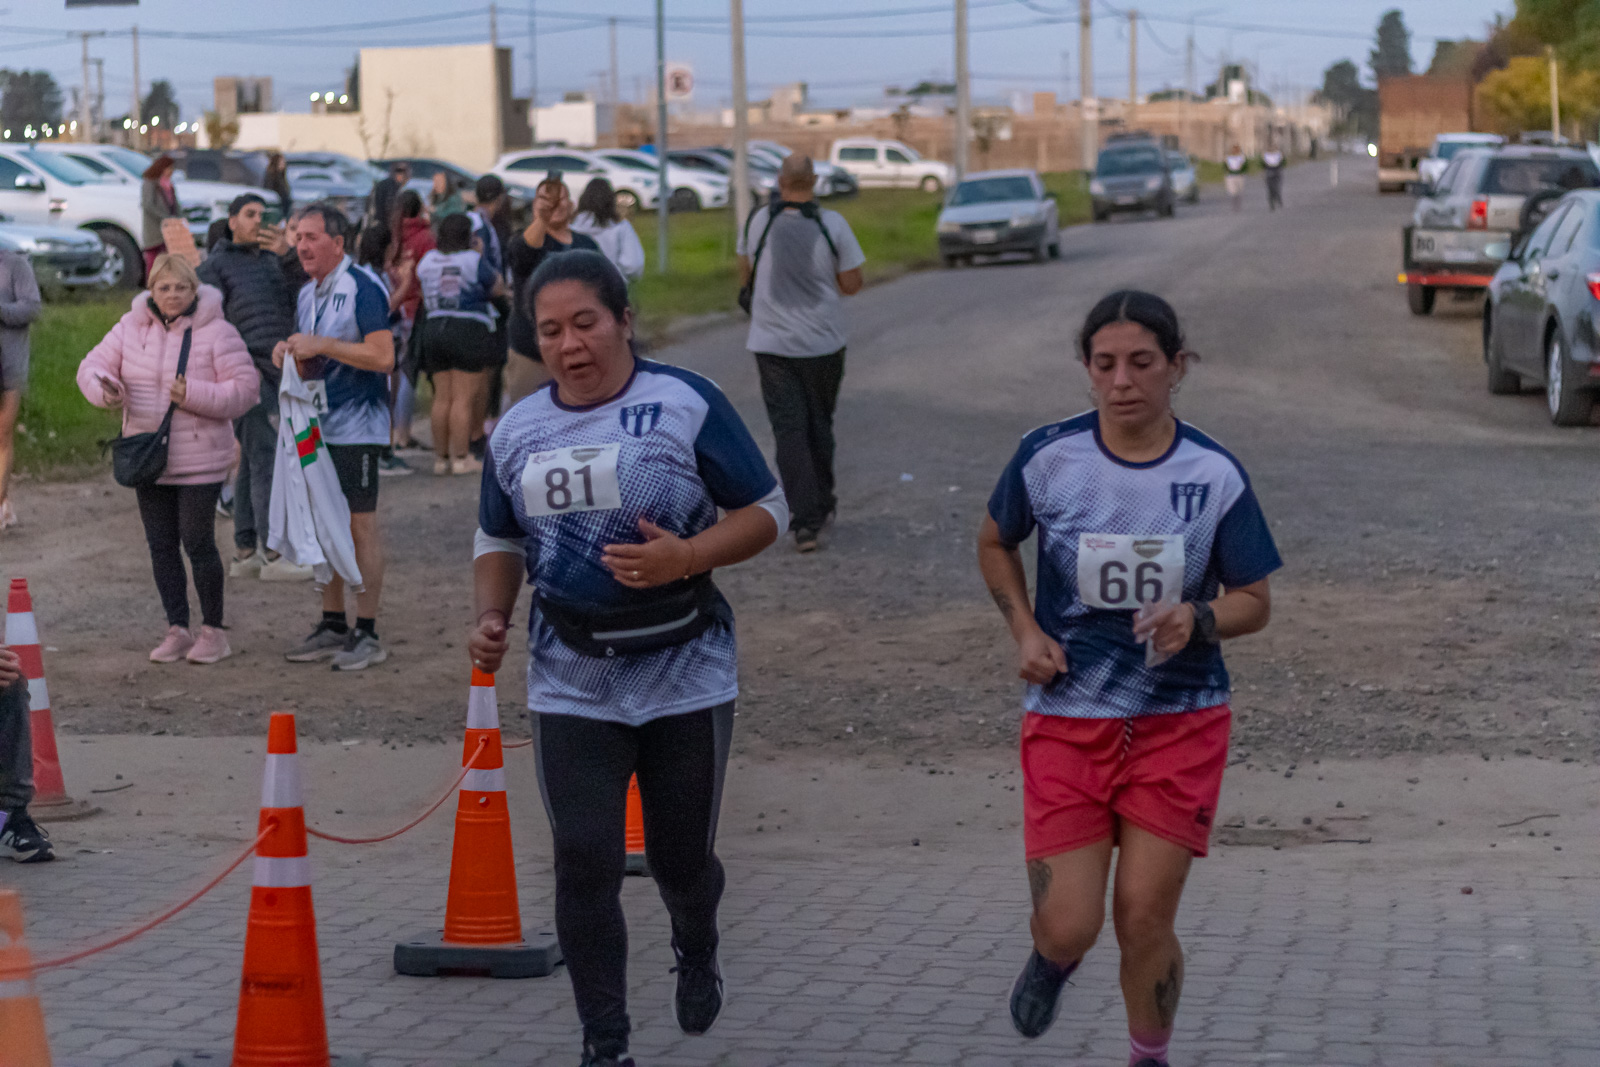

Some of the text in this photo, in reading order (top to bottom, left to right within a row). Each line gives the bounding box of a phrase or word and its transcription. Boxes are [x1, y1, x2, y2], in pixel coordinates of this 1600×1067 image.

[626, 404, 655, 416] SFC
[545, 465, 595, 510] 81
[1177, 485, 1204, 497] SFC
[1100, 560, 1163, 605] 66
